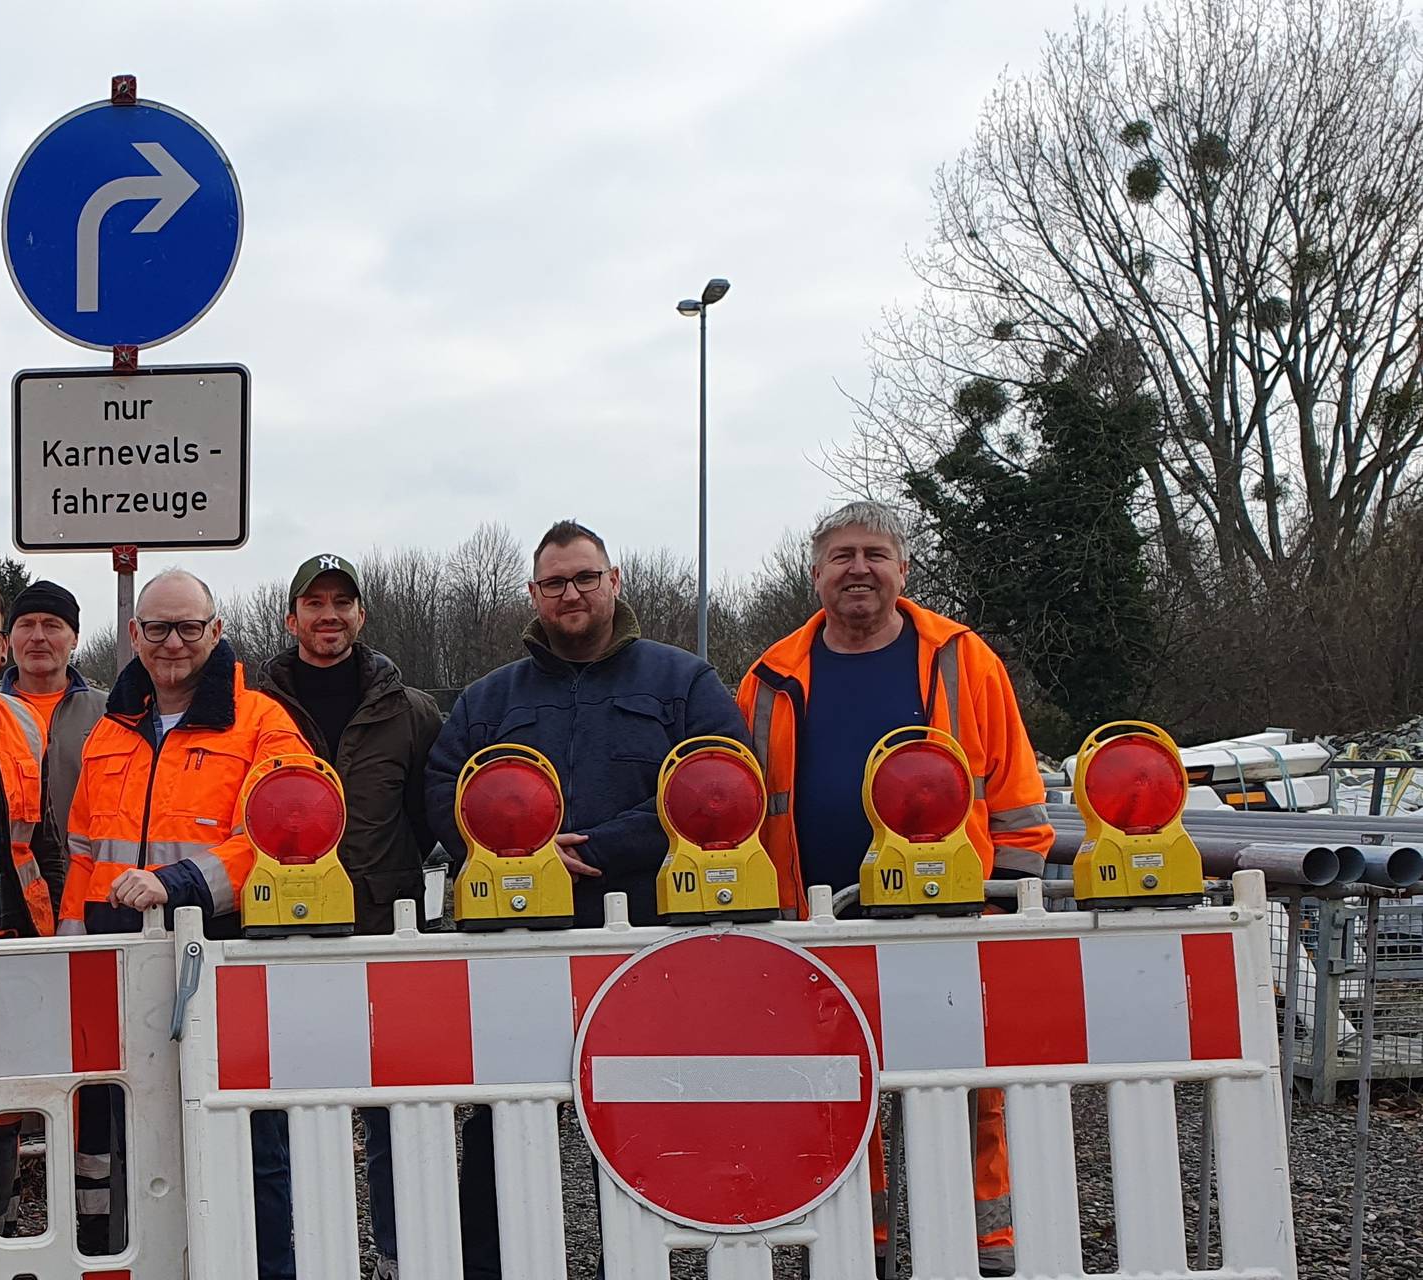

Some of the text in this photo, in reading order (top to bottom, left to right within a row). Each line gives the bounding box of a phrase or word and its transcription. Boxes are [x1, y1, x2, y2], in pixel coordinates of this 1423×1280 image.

[104, 399, 153, 420] nur
[42, 436, 199, 467] Karnevals
[51, 487, 208, 519] fahrzeuge
[672, 871, 696, 893] VD
[880, 869, 903, 890] VD
[1099, 864, 1117, 881] VD
[253, 885, 271, 902] VD
[470, 881, 488, 898] VD
